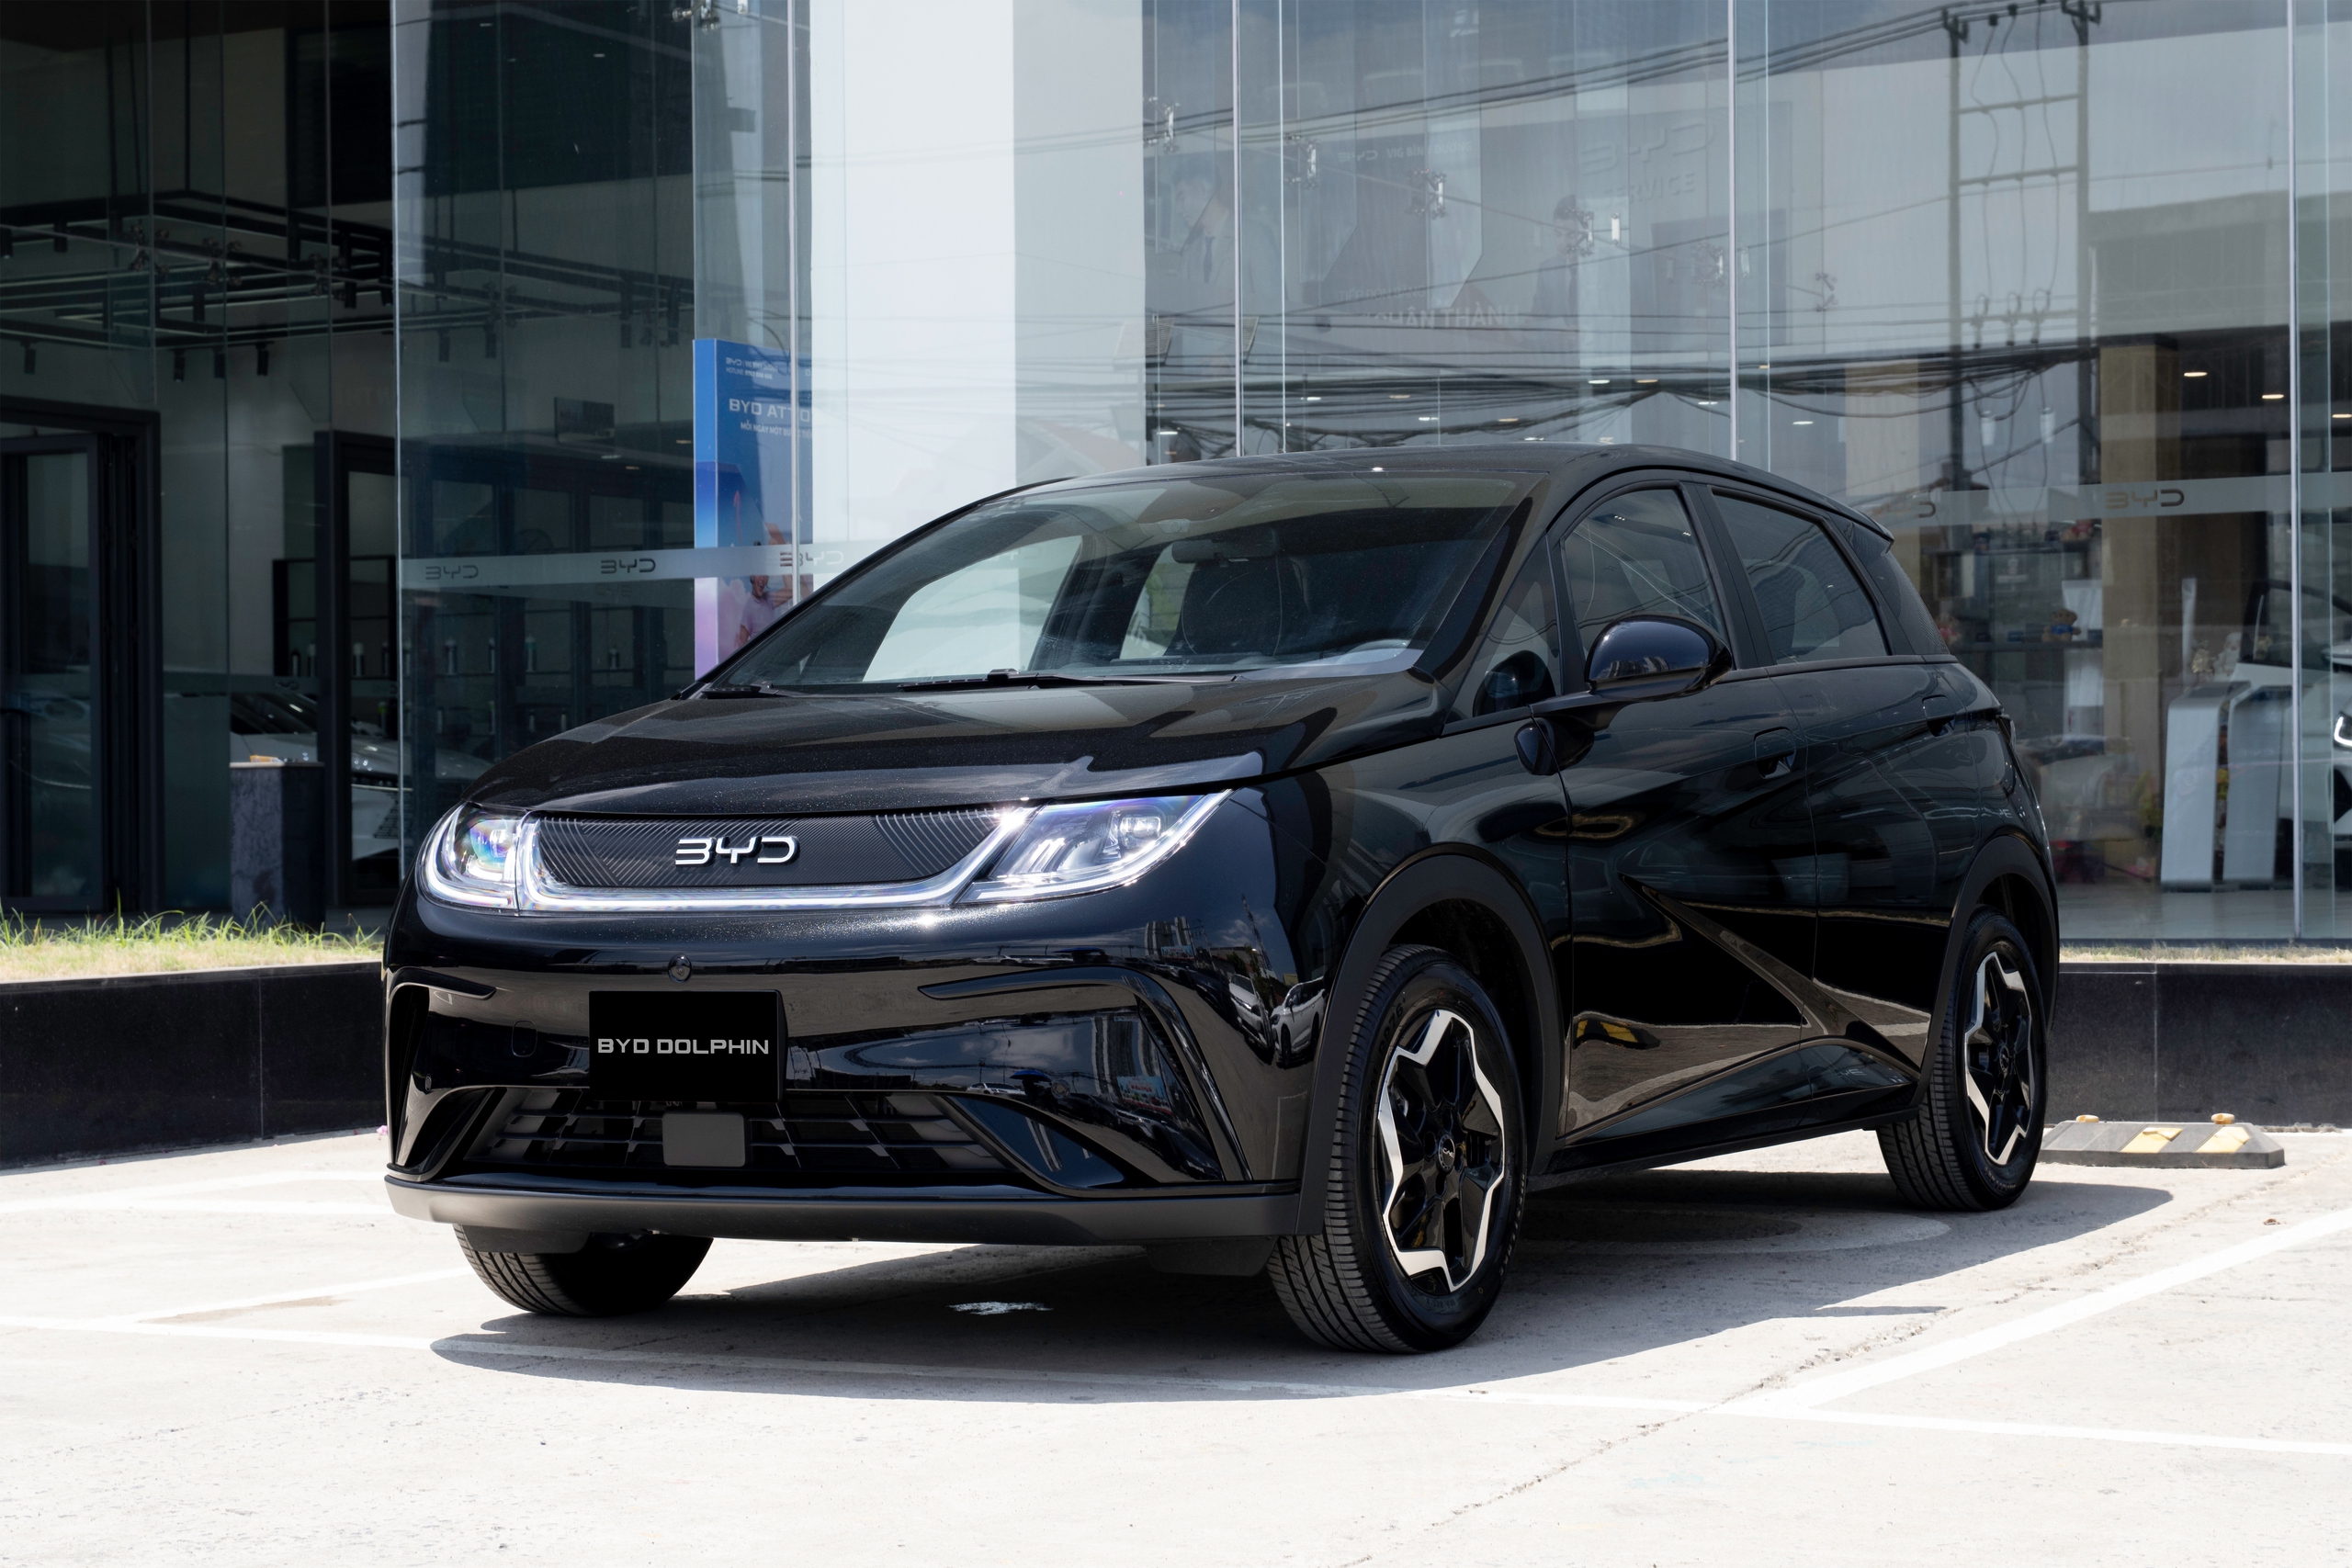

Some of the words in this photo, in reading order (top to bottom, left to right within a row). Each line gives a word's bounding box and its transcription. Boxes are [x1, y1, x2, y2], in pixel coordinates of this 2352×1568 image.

[729, 398, 763, 416] BYD
[2105, 489, 2185, 509] BYD
[600, 558, 657, 574] BYD
[780, 550, 844, 567] BYD
[425, 564, 480, 581] BYD
[675, 836, 799, 866] BYD
[598, 1038, 650, 1055] BYD
[657, 1038, 769, 1055] DOLPHIN
